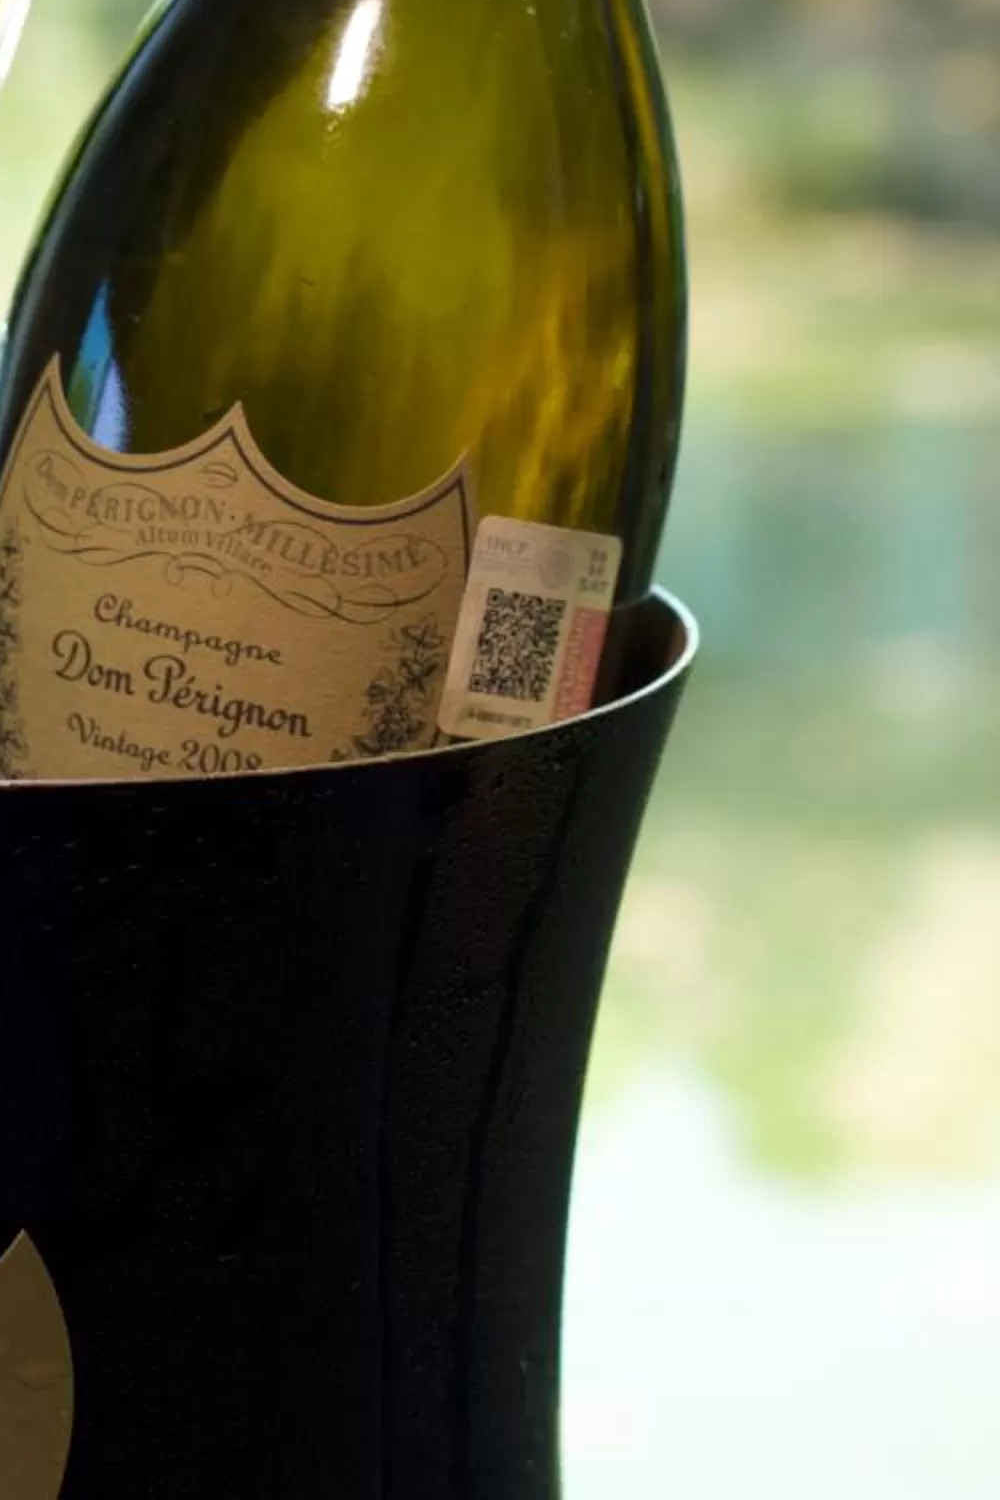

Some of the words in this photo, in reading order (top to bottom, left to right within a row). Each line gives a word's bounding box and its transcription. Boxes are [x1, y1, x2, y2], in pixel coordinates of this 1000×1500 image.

[93, 593, 285, 666] Champagne
[52, 629, 136, 696] Dom
[143, 654, 313, 738] Pérignon
[66, 712, 172, 771] Vintage
